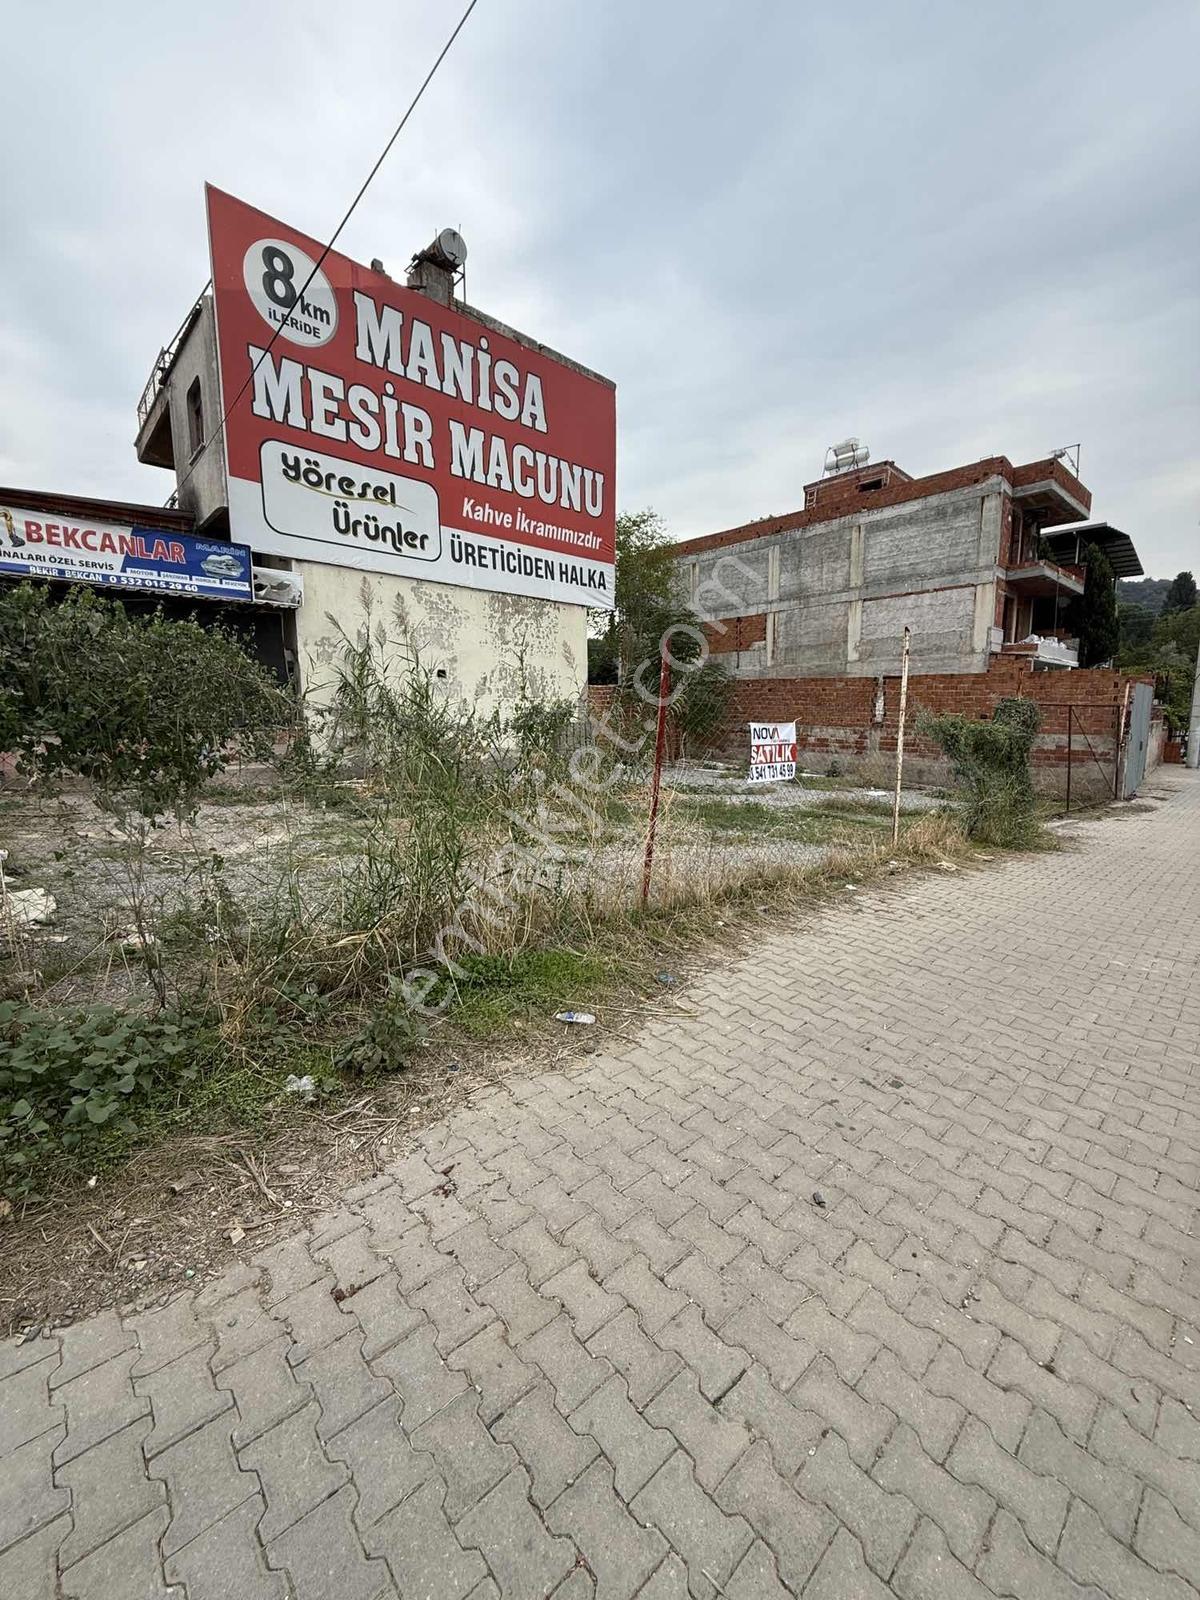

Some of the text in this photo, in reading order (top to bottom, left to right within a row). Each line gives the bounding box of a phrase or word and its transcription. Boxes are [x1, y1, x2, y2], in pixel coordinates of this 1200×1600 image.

[262, 246, 331, 326] 8 km
[353, 289, 548, 434] MANİSA
[247, 342, 604, 518] MESİR MACUNU
[333, 500, 429, 553] Ürünler
[463, 497, 513, 528] Kahve
[24, 520, 186, 564] BEKCANLAR
[48, 554, 76, 566] ÖZEL
[65, 570, 103, 582] BEKCAN
[109, 575, 117, 583] 0
[120, 576, 143, 587] 532
[169, 582, 182, 590] 29
[184, 583, 198, 592] 60
[451, 534, 607, 591] ÜRETİCİDEN HALKA
[753, 727, 780, 740] NOVA
[750, 744, 793, 764] SATILIK
[755, 765, 767, 780] 541
[767, 764, 778, 779] 731
[779, 764, 786, 778] 45
